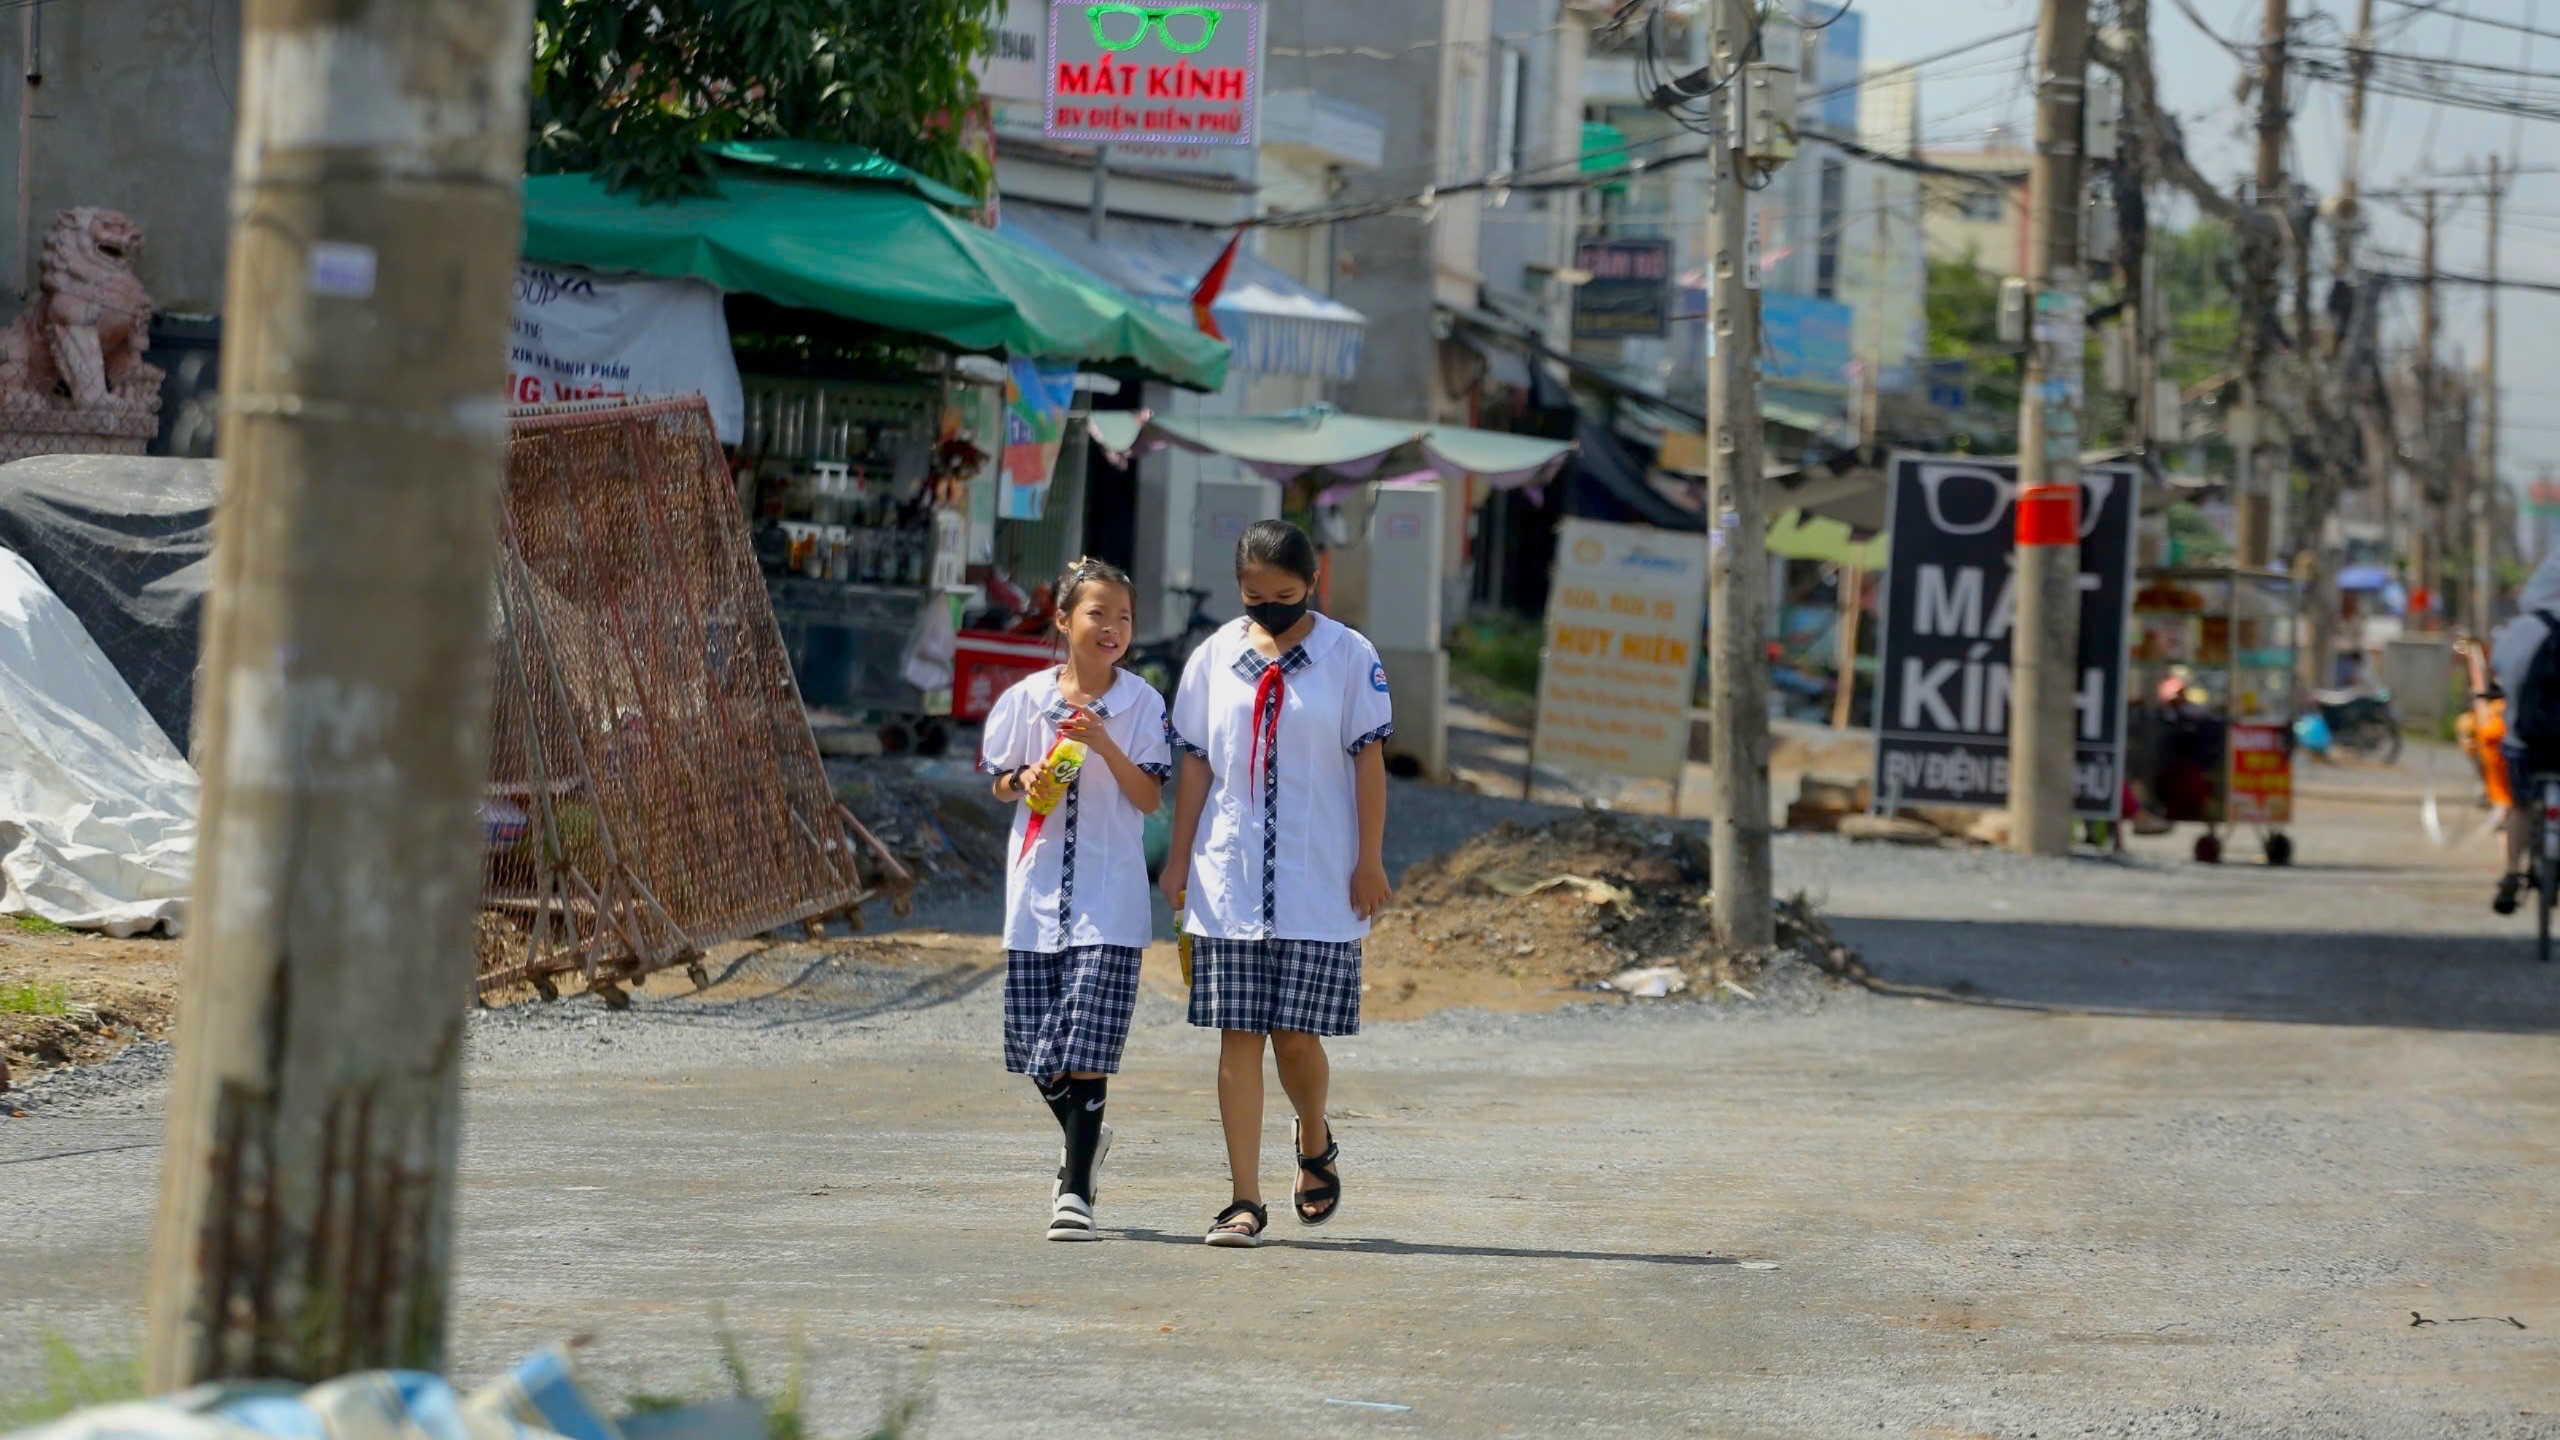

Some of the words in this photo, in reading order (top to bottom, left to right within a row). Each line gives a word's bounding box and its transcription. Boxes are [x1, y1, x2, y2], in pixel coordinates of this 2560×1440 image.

[1146, 57, 1246, 101] KÍNH
[1056, 106, 1084, 128] BV
[1055, 760, 1079, 784] C2
